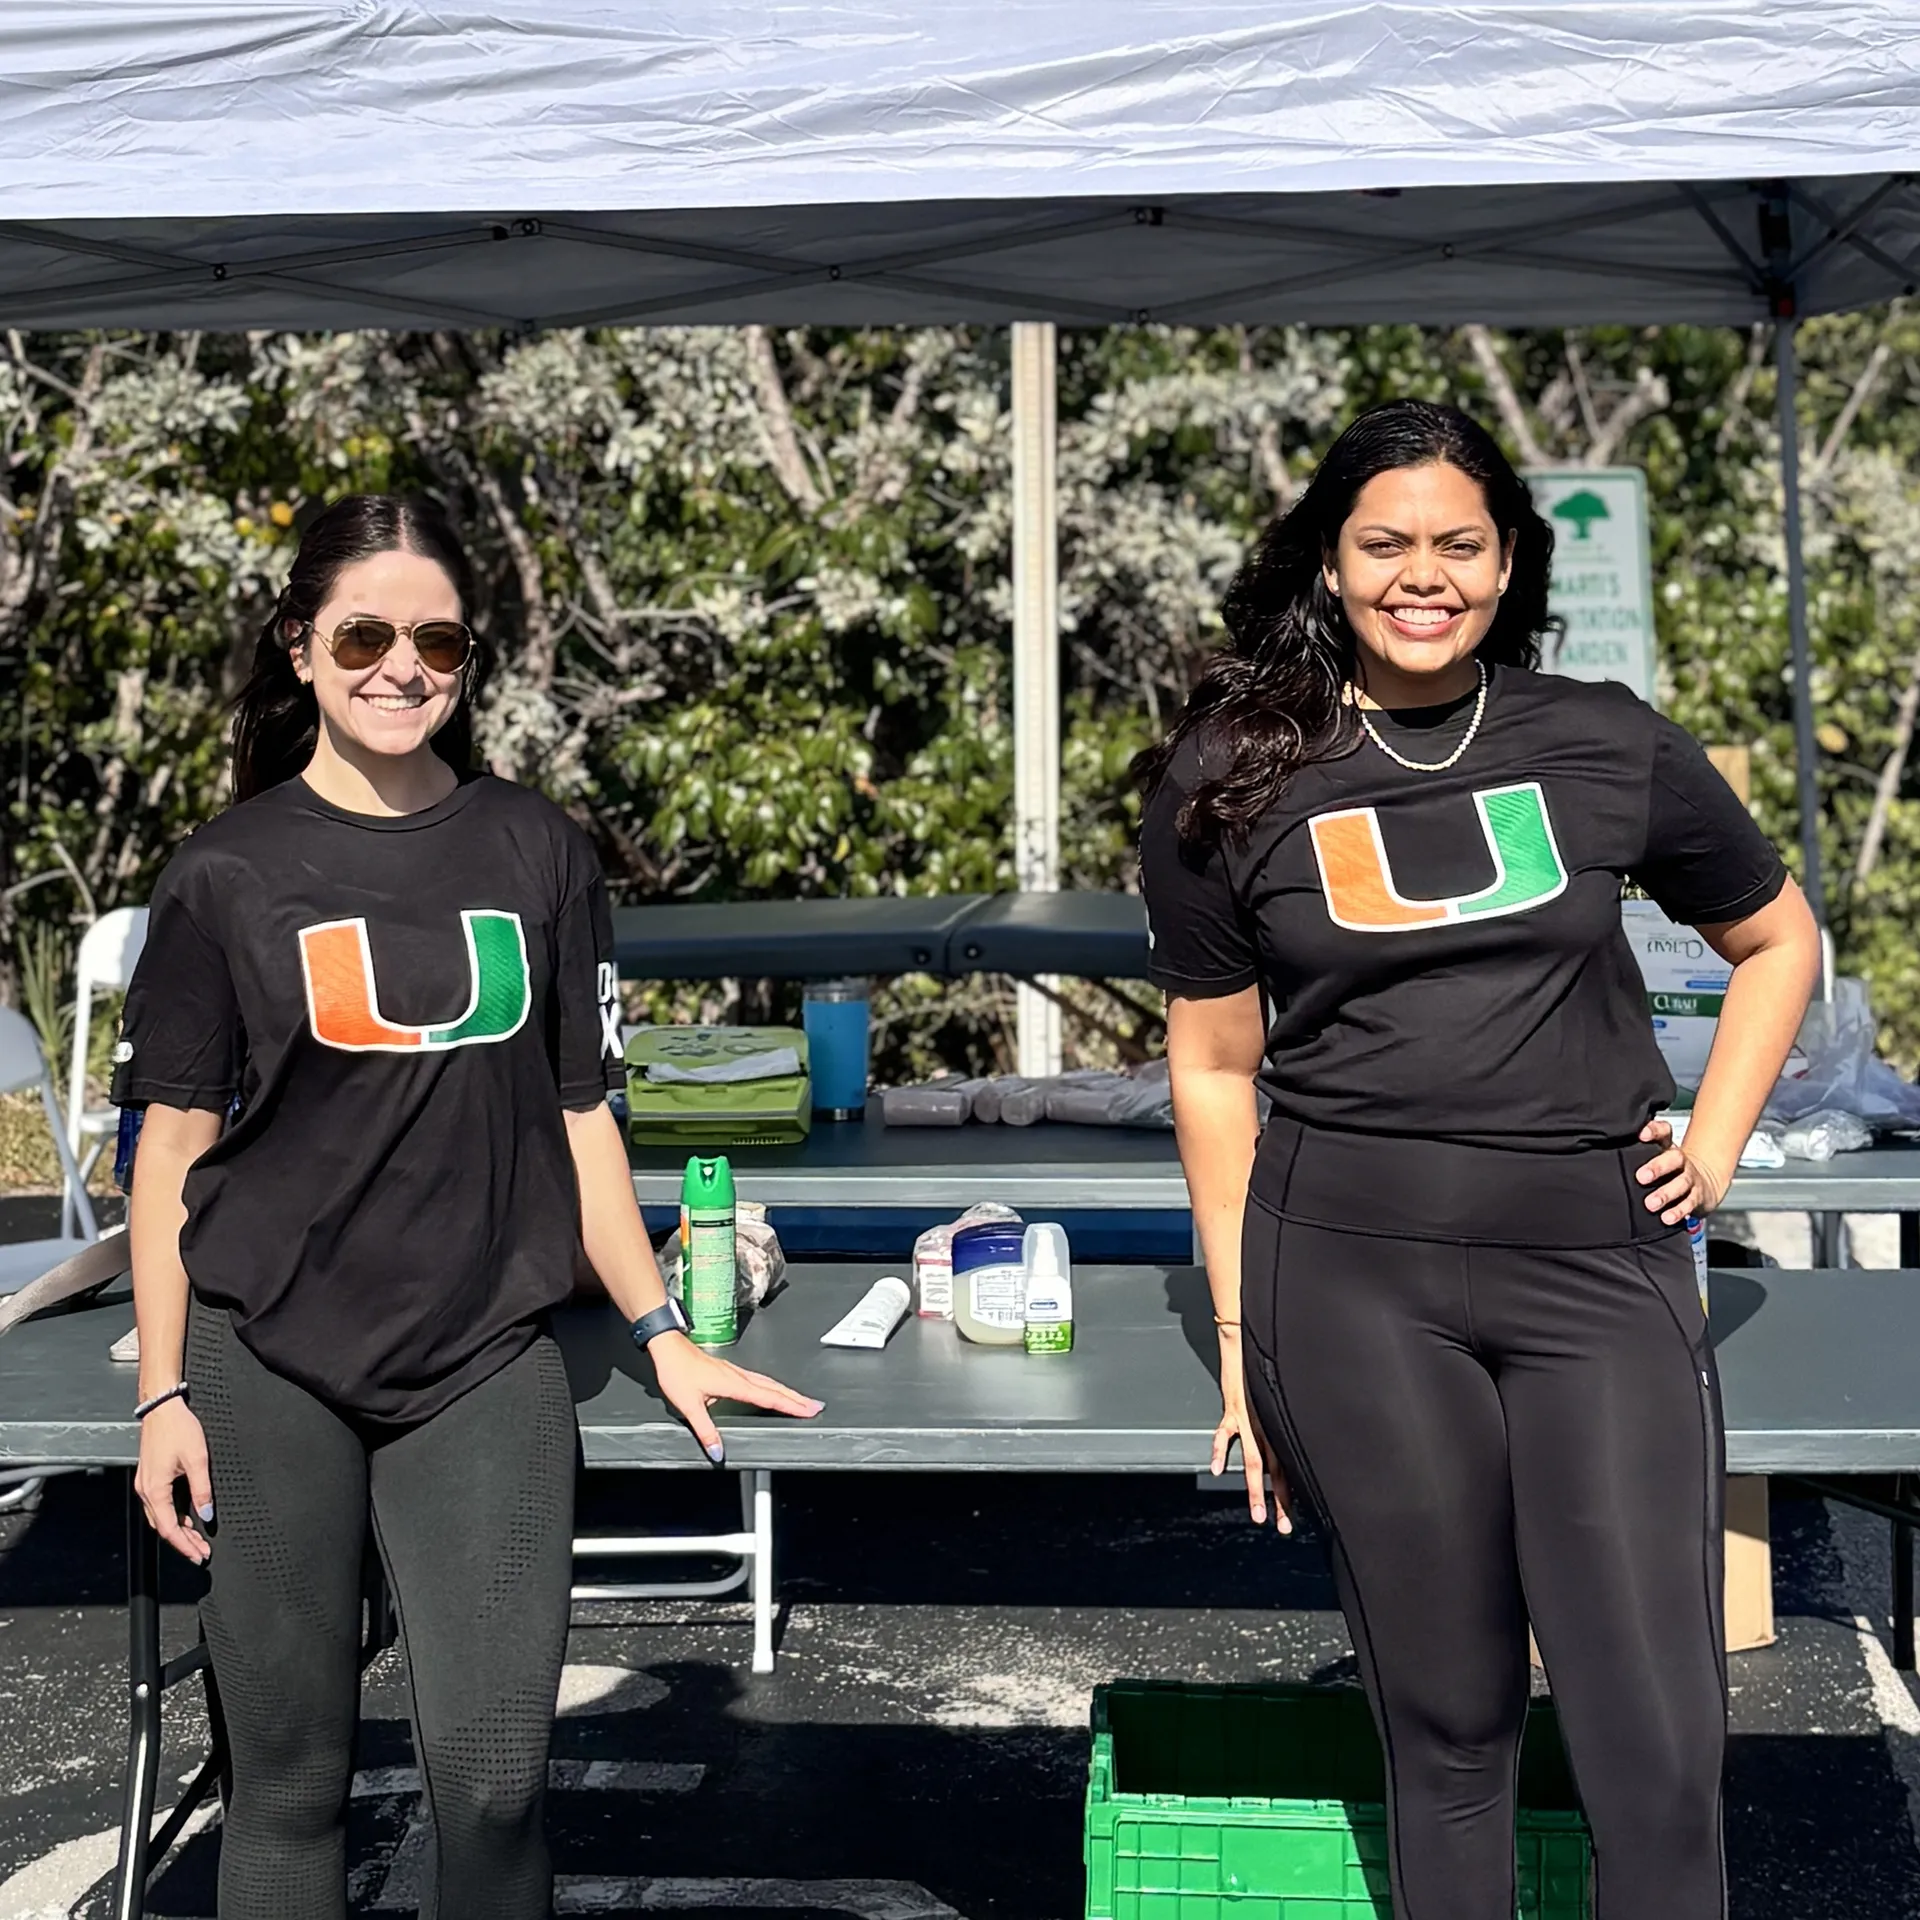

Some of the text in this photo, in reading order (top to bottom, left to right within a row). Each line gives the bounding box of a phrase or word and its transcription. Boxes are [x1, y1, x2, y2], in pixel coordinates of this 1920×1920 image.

[1562, 642, 1628, 665] ARDEN
[1308, 782, 1570, 932] U
[298, 908, 532, 1053] U
